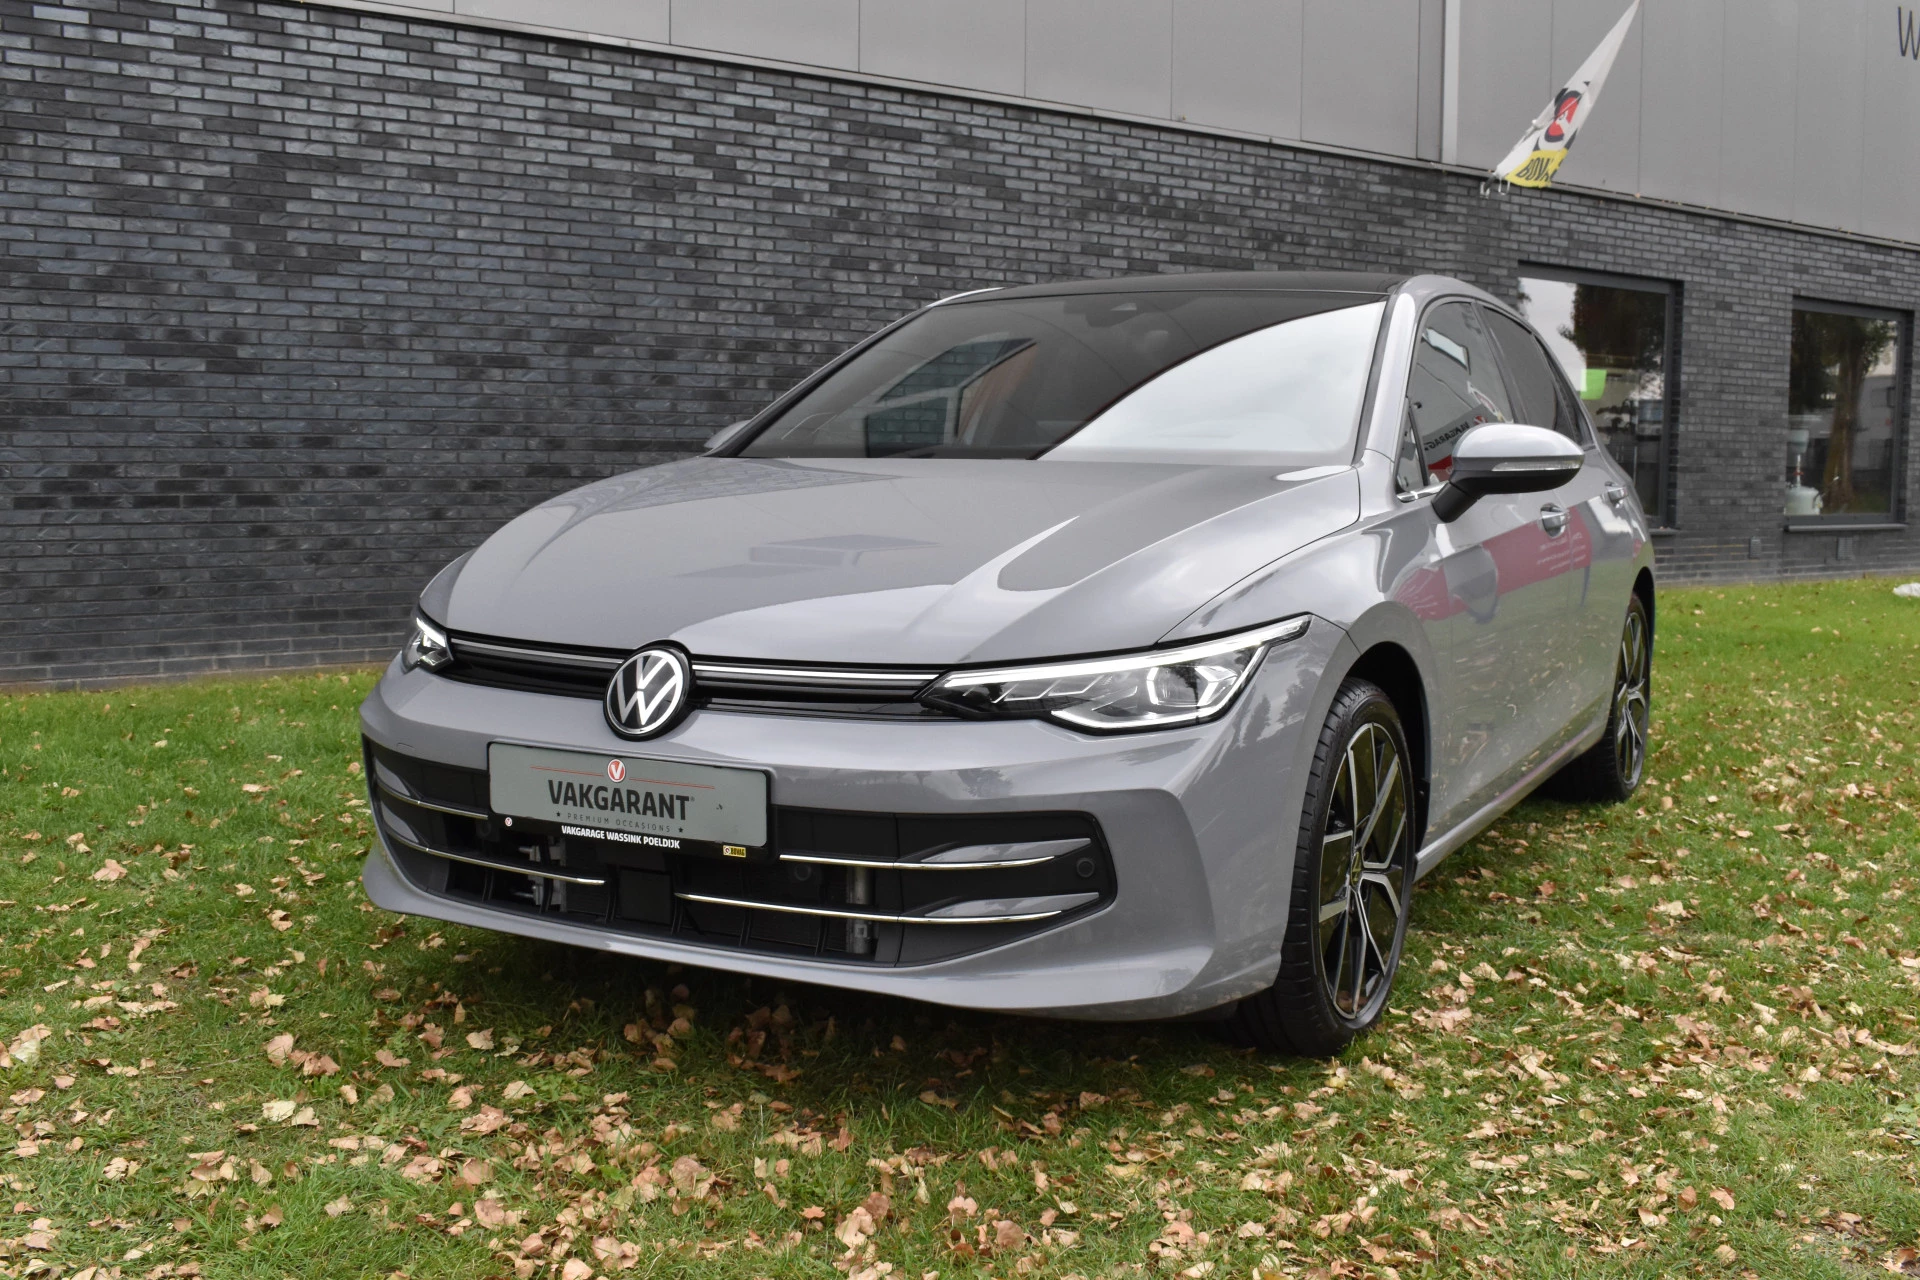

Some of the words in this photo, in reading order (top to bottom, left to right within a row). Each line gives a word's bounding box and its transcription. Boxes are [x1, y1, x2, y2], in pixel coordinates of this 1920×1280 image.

[548, 779, 690, 821] VAKGARANT
[567, 812, 609, 825] PREMIUM
[615, 818, 671, 833] OCCASIONS
[561, 825, 605, 839] VAKGARAGE
[606, 831, 642, 844] WASSINK
[643, 835, 680, 849] POELDIJK
